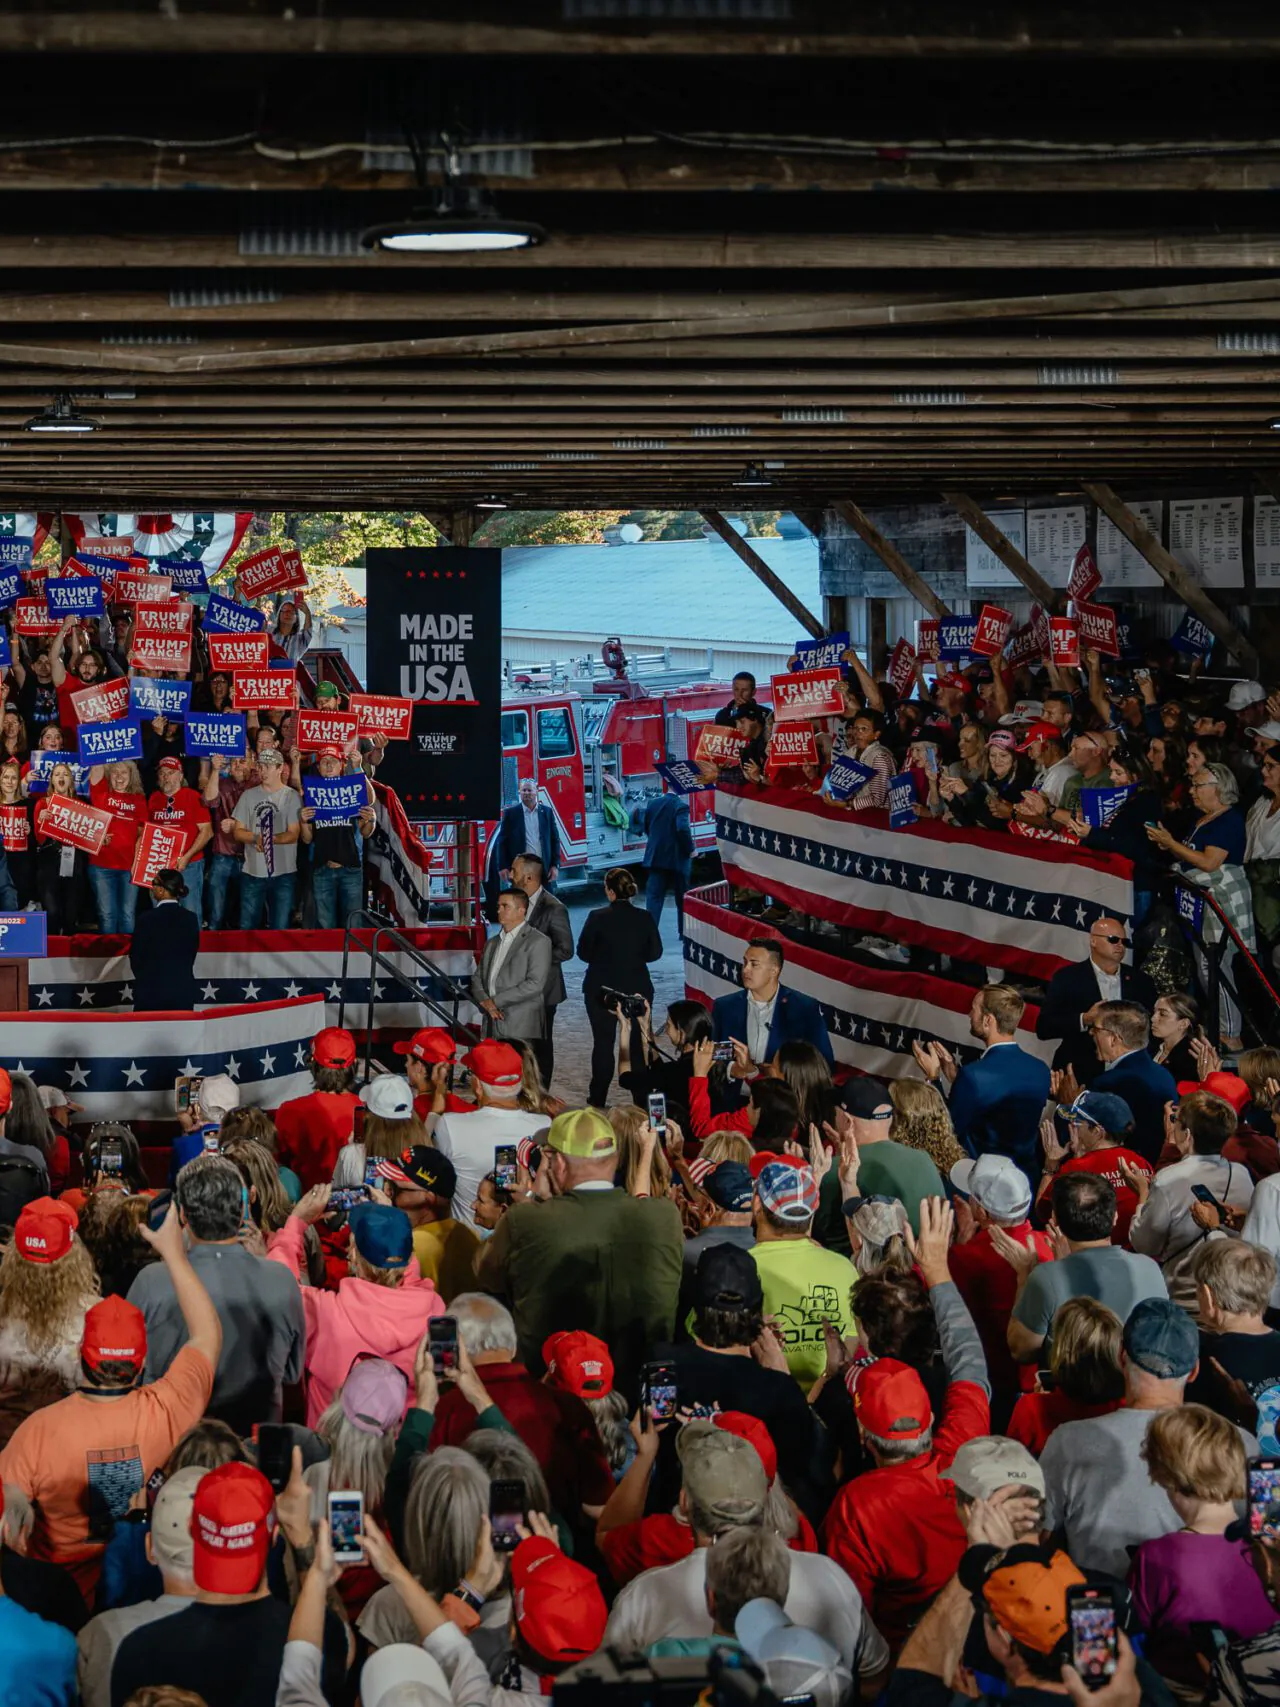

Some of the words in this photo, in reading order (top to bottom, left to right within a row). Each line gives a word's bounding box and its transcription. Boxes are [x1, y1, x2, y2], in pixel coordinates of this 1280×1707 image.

[84, 546, 131, 556] TRUMP
[161, 567, 201, 579] TRUMP
[240, 555, 280, 580] TRUMP
[245, 567, 278, 586] VANCE
[49, 586, 99, 597] TRUMP
[119, 580, 171, 594] TRUMP
[55, 595, 94, 606] VANCE
[122, 590, 161, 602] VANCE
[139, 611, 190, 621] TRUMP
[212, 603, 259, 628] TRUMP
[145, 620, 184, 630] VANCE
[400, 614, 473, 640] MADE
[1082, 626, 1110, 639] VANCE
[136, 638, 188, 651] TRUMP
[212, 643, 266, 653] TRUMP
[141, 648, 181, 658] VANCE
[219, 652, 261, 660] VANCE
[410, 644, 427, 661] IN
[431, 644, 464, 661] THE
[798, 643, 846, 659] TRUMP
[802, 654, 840, 668] VANCE
[236, 678, 292, 689] TRUMP
[400, 665, 475, 701] USA
[776, 680, 838, 696] TRUMP
[134, 687, 187, 700] TRUMP
[242, 687, 285, 697] VANCE
[784, 690, 833, 704] VANCE
[78, 687, 128, 712] TRUMP
[139, 698, 180, 709] VANCE
[353, 705, 408, 717] TRUMP
[188, 722, 242, 734] TRUMP
[301, 719, 355, 733] TRUMP
[82, 728, 137, 744] TRUMP
[194, 733, 235, 743] VANCE
[306, 730, 348, 741] VANCE
[417, 735, 456, 743] TRUMP
[772, 731, 812, 744] TRUMP
[89, 739, 131, 751] VANCE
[776, 743, 808, 752] VANCE
[546, 765, 572, 780] ENGINE
[831, 763, 865, 785] TRUMP
[307, 784, 363, 798] TRUMP
[558, 780, 562, 792] 1
[314, 796, 357, 807] VANCE
[51, 804, 105, 831] TRUMP
[154, 811, 185, 820] TRUMP
[53, 815, 95, 838] VANCE
[144, 829, 165, 882] TRUMP
[25, 1236, 46, 1248] USA
